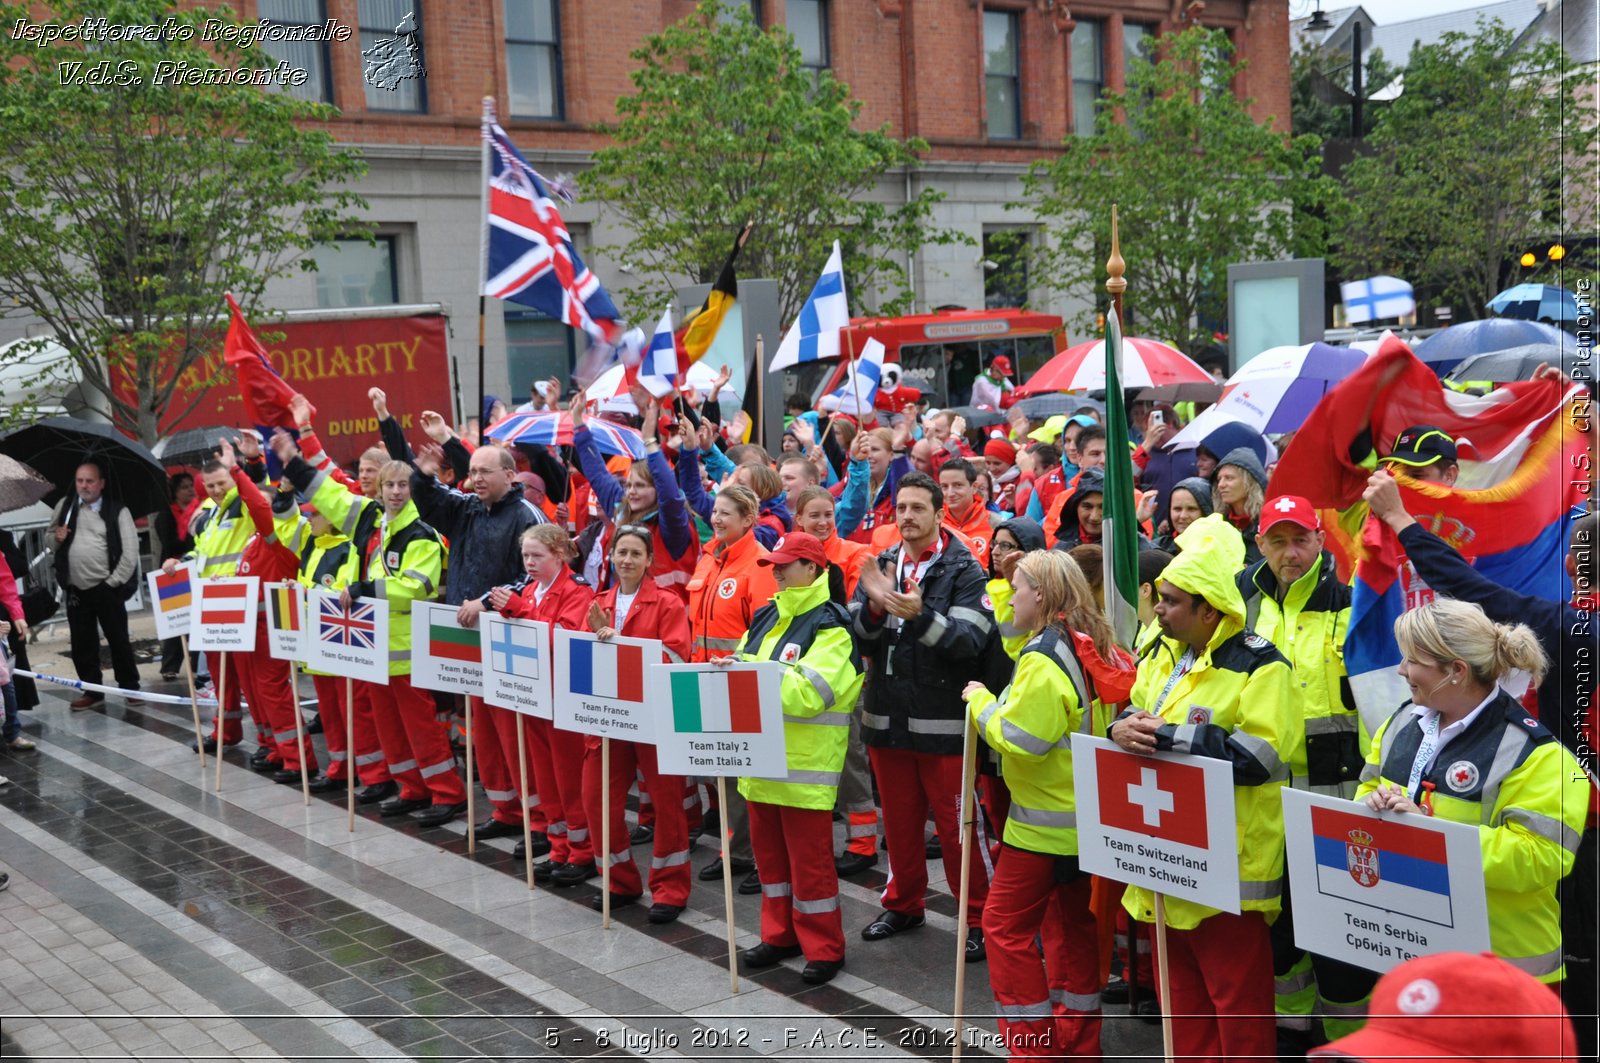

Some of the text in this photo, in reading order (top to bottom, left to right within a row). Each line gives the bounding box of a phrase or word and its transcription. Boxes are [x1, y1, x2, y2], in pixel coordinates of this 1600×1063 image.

[269, 336, 422, 381] ORIARTY
[328, 414, 413, 436] DUNDK
[202, 637, 215, 645] Team
[321, 650, 374, 666] Team Great Britain
[440, 664, 483, 678] Team Bulga
[1162, 663, 1183, 696] DUNDALK
[438, 674, 483, 687] Team Бълга
[499, 679, 533, 693] Team Finland
[495, 690, 538, 707] Suomen Joukkue
[582, 702, 630, 717] Team France
[574, 713, 638, 731] Equipe de France
[688, 741, 749, 753] Team Italy 2
[688, 756, 752, 767] Team Italia 2
[1103, 836, 1208, 872] Team Switzerland
[1114, 857, 1198, 889] Team Schweiz
[1344, 912, 1428, 946] Team Serbia
[1346, 933, 1420, 962] Србија Te
